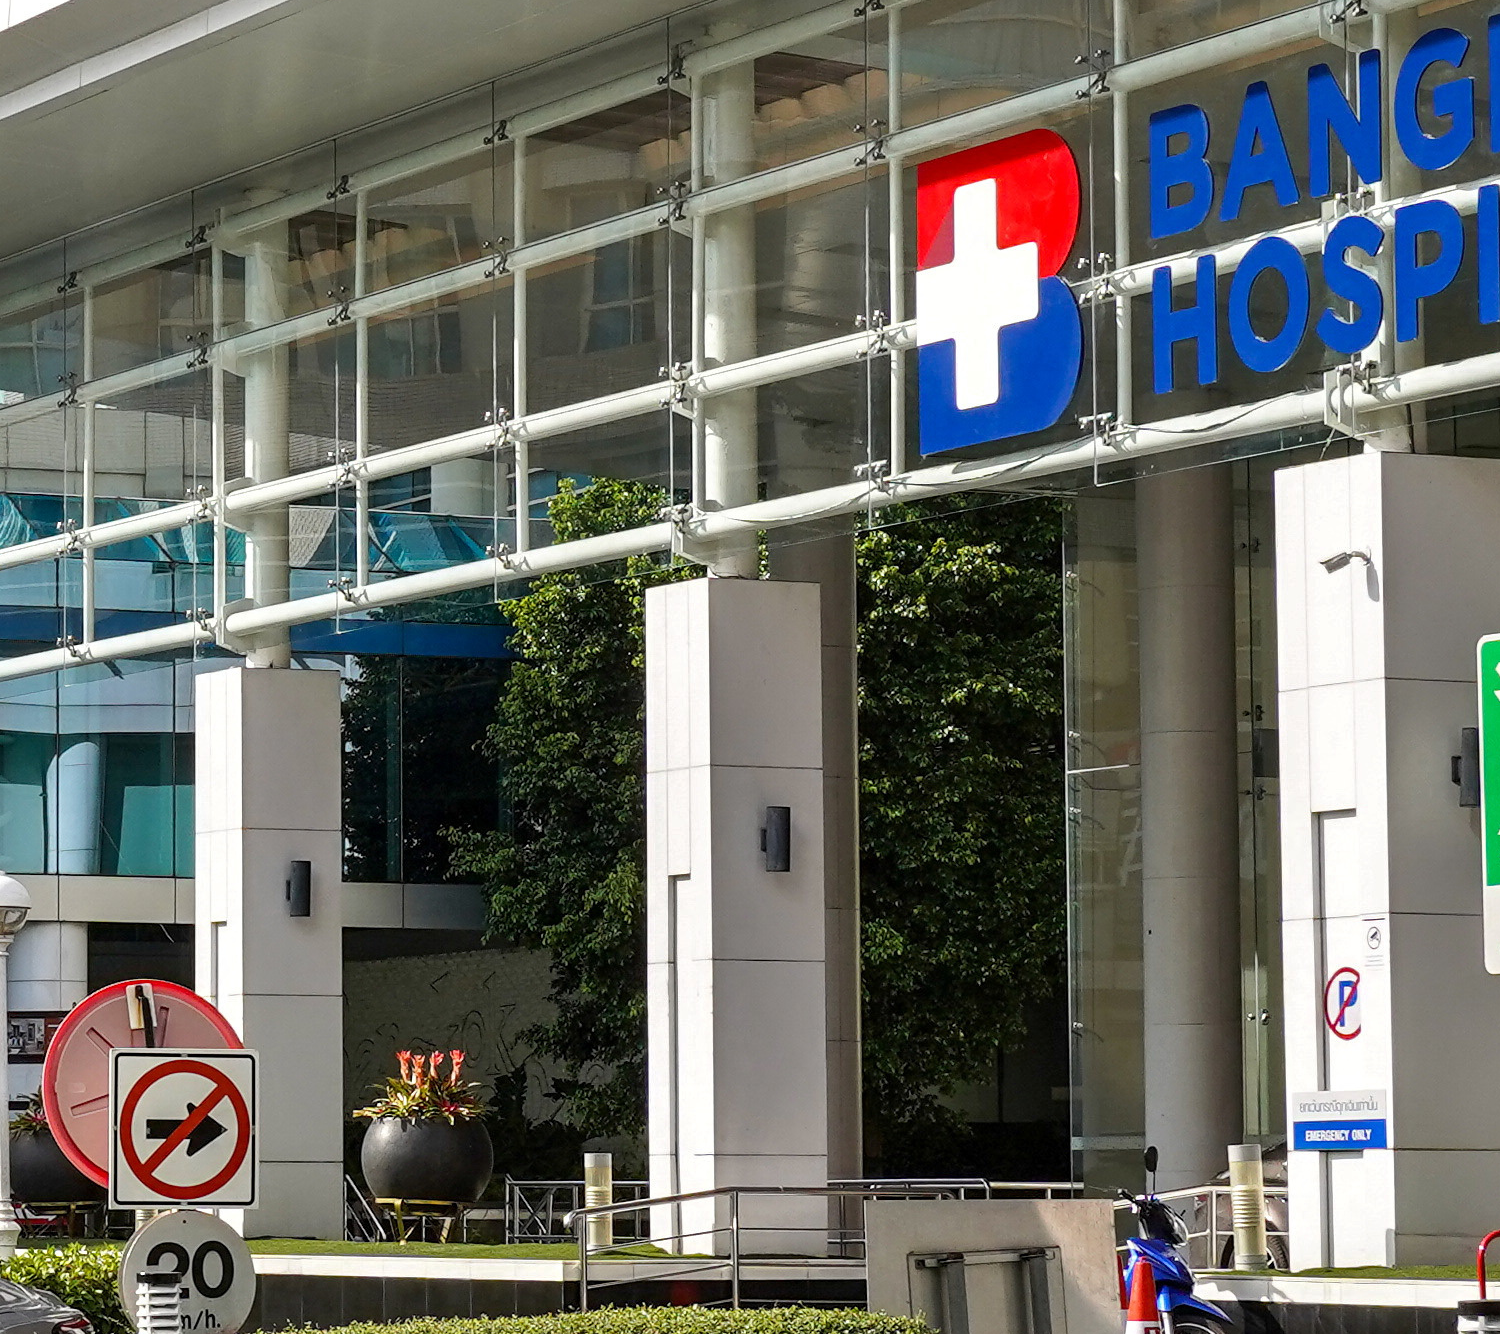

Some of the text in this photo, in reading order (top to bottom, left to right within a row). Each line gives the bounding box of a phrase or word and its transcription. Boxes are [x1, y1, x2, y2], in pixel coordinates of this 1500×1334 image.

[1305, 1129, 1372, 1142] EMERGENCY ONLY
[146, 1240, 235, 1300] 20
